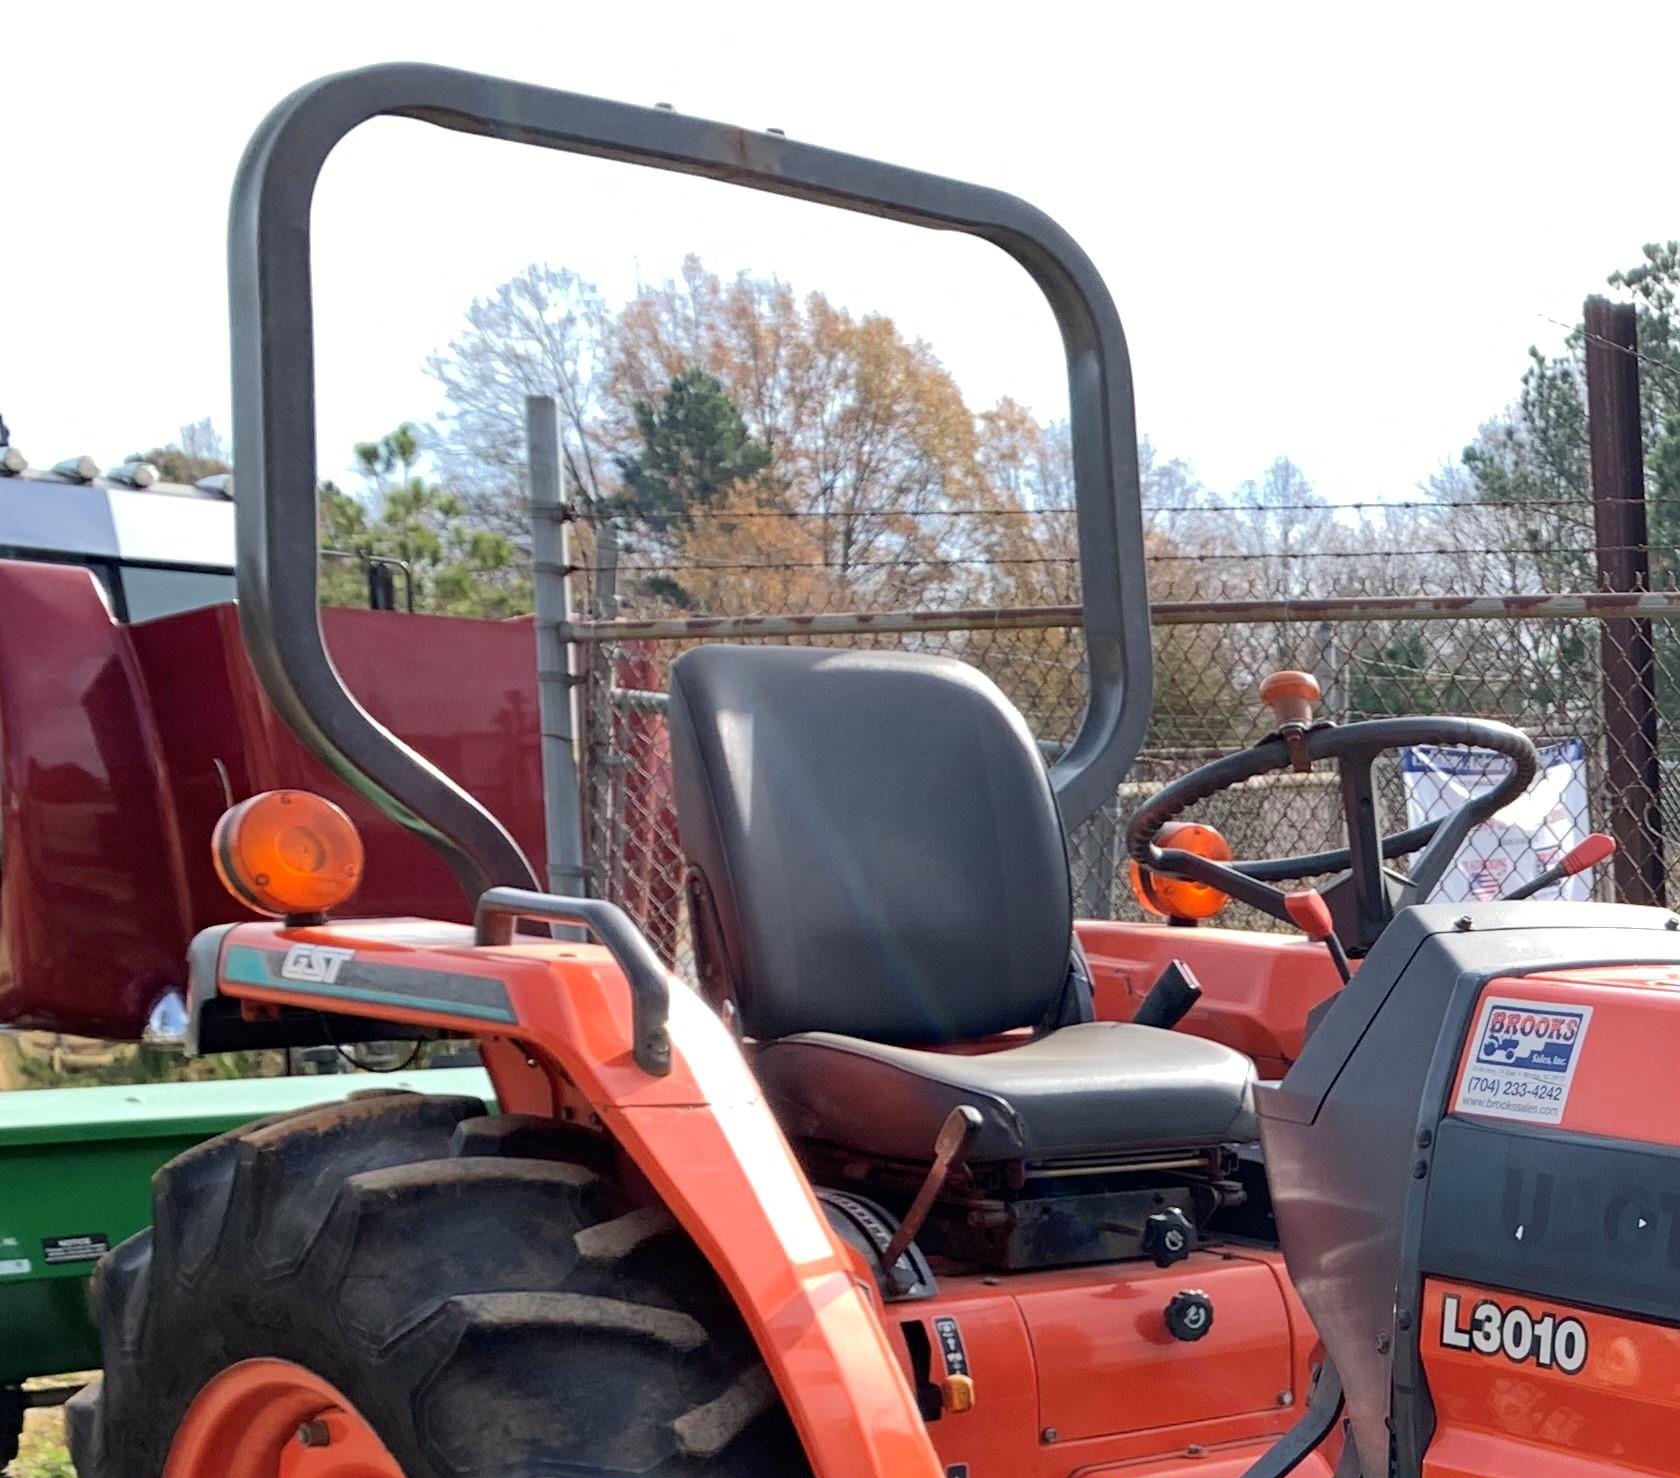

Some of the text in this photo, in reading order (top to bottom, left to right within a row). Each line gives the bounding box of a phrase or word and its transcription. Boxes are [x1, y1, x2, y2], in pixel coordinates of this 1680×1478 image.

[281, 943, 357, 984] GST
[1489, 1011, 1578, 1041] BROOKS
[1468, 1076, 1562, 1101] (704) 233-4242
[1441, 1294, 1588, 1375] L3010
